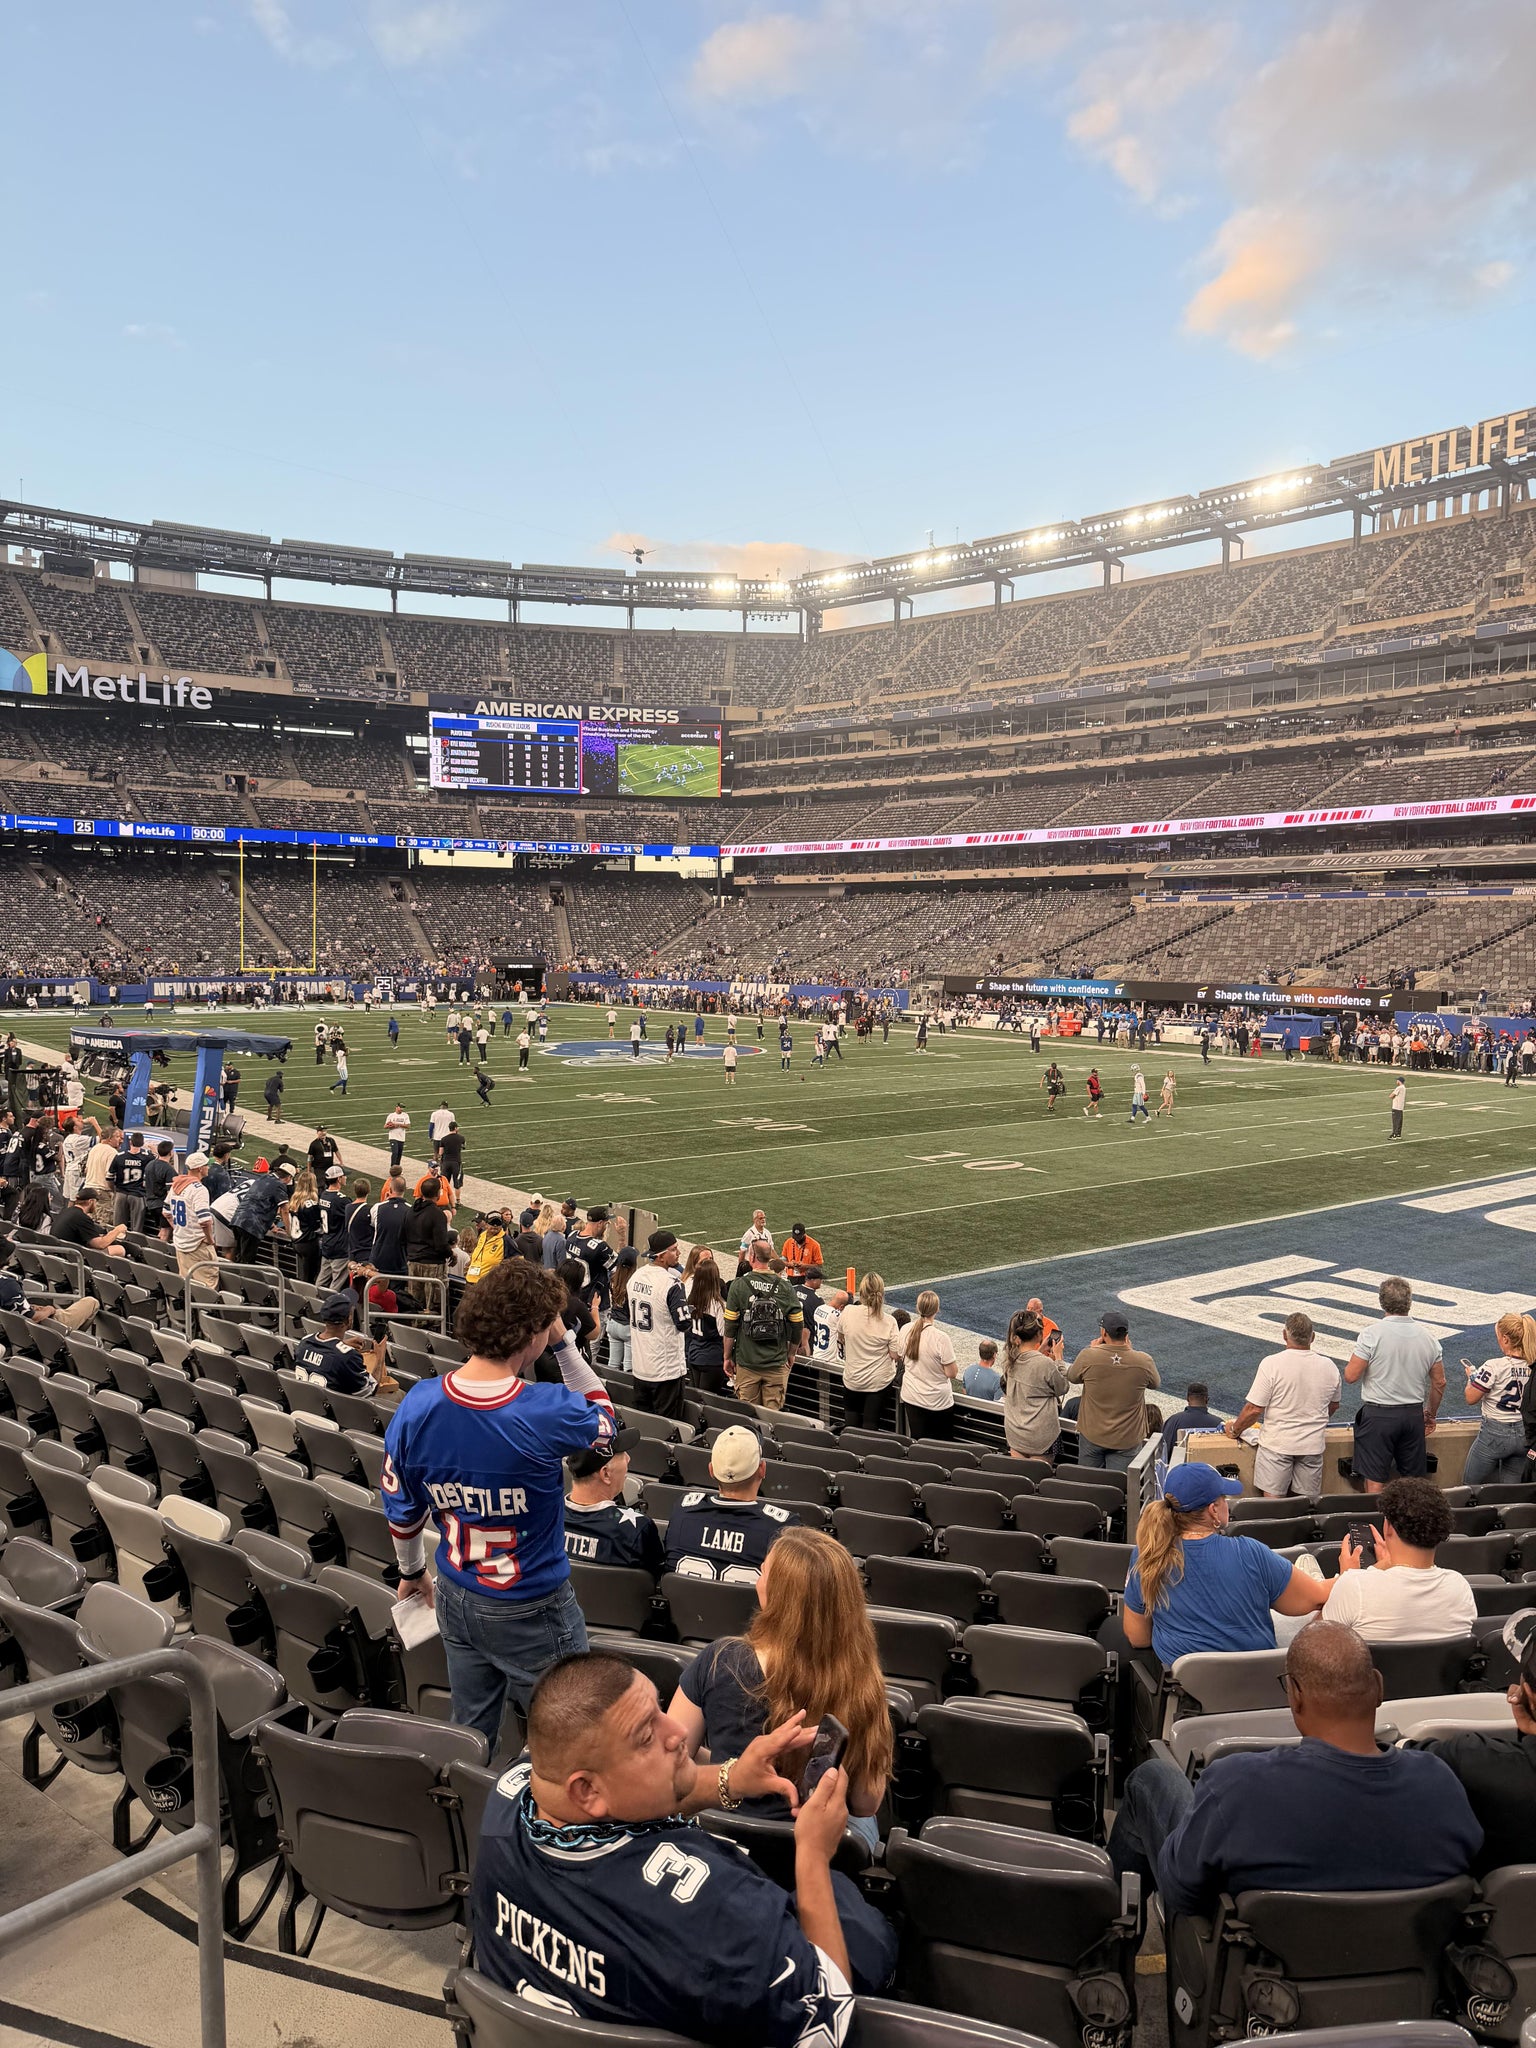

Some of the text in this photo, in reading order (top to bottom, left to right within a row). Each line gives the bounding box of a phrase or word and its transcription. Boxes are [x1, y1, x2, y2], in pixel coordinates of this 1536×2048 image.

[1373, 411, 1529, 490] METLIFE
[55, 663, 213, 710] MetLife
[474, 701, 680, 724] AMERICAN EXPRESS
[681, 731, 708, 739] accenture
[1394, 807, 1408, 817] NEW
[1425, 803, 1465, 814] FOOTBALL
[1466, 801, 1497, 812] GIANTS
[76, 822, 92, 832] 25
[136, 825, 175, 837] MetLife
[1179, 822, 1192, 831] NEW
[1205, 818, 1237, 830] FOOTBALL
[1238, 816, 1265, 827] GIANTS
[193, 829, 224, 839] 90:00
[1069, 828, 1097, 837] FOOTBALL
[1098, 826, 1121, 836] GIANTS
[350, 836, 367, 844] BALL
[623, 845, 632, 853] 34
[1307, 853, 1427, 867] METLIFE STADIUM
[376, 979, 391, 990] 25
[989, 982, 1109, 995] Shape the future with confidence
[1215, 990, 1371, 1006] Shape the future with confidence
[90, 1037, 123, 1050] AMERICA
[197, 1106, 214, 1152] FNIA
[123, 1168, 142, 1184] 13
[633, 1281, 653, 1296] DOWNS
[631, 1297, 654, 1333] 13
[303, 1349, 324, 1367] LAMB
[700, 1526, 745, 1553] LAMB
[440, 1510, 523, 1591] 15
[641, 1841, 711, 1904] 3
[495, 1891, 606, 1998] PICKENS
